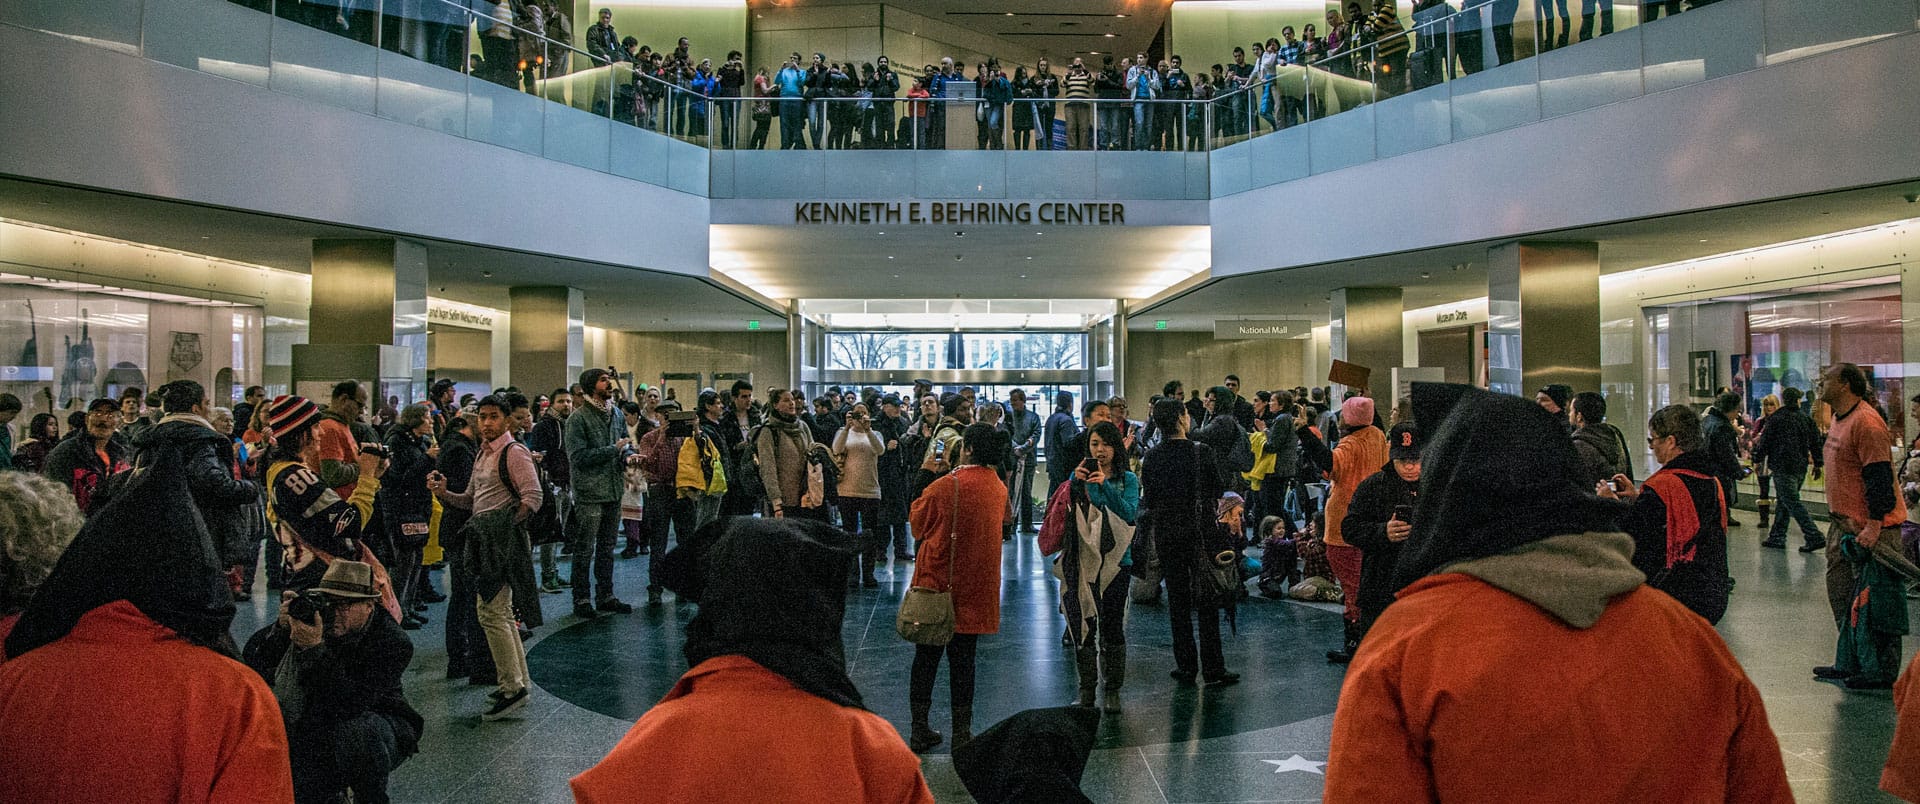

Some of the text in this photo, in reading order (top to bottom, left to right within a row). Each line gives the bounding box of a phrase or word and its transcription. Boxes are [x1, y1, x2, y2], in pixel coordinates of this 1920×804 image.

[795, 202, 1125, 223] KENNETH E. BEHRING CENTER
[460, 311, 479, 324] Welcome
[1436, 309, 1468, 323] Museum Store
[1239, 325, 1288, 334] National Mall
[1401, 431, 1412, 447] B
